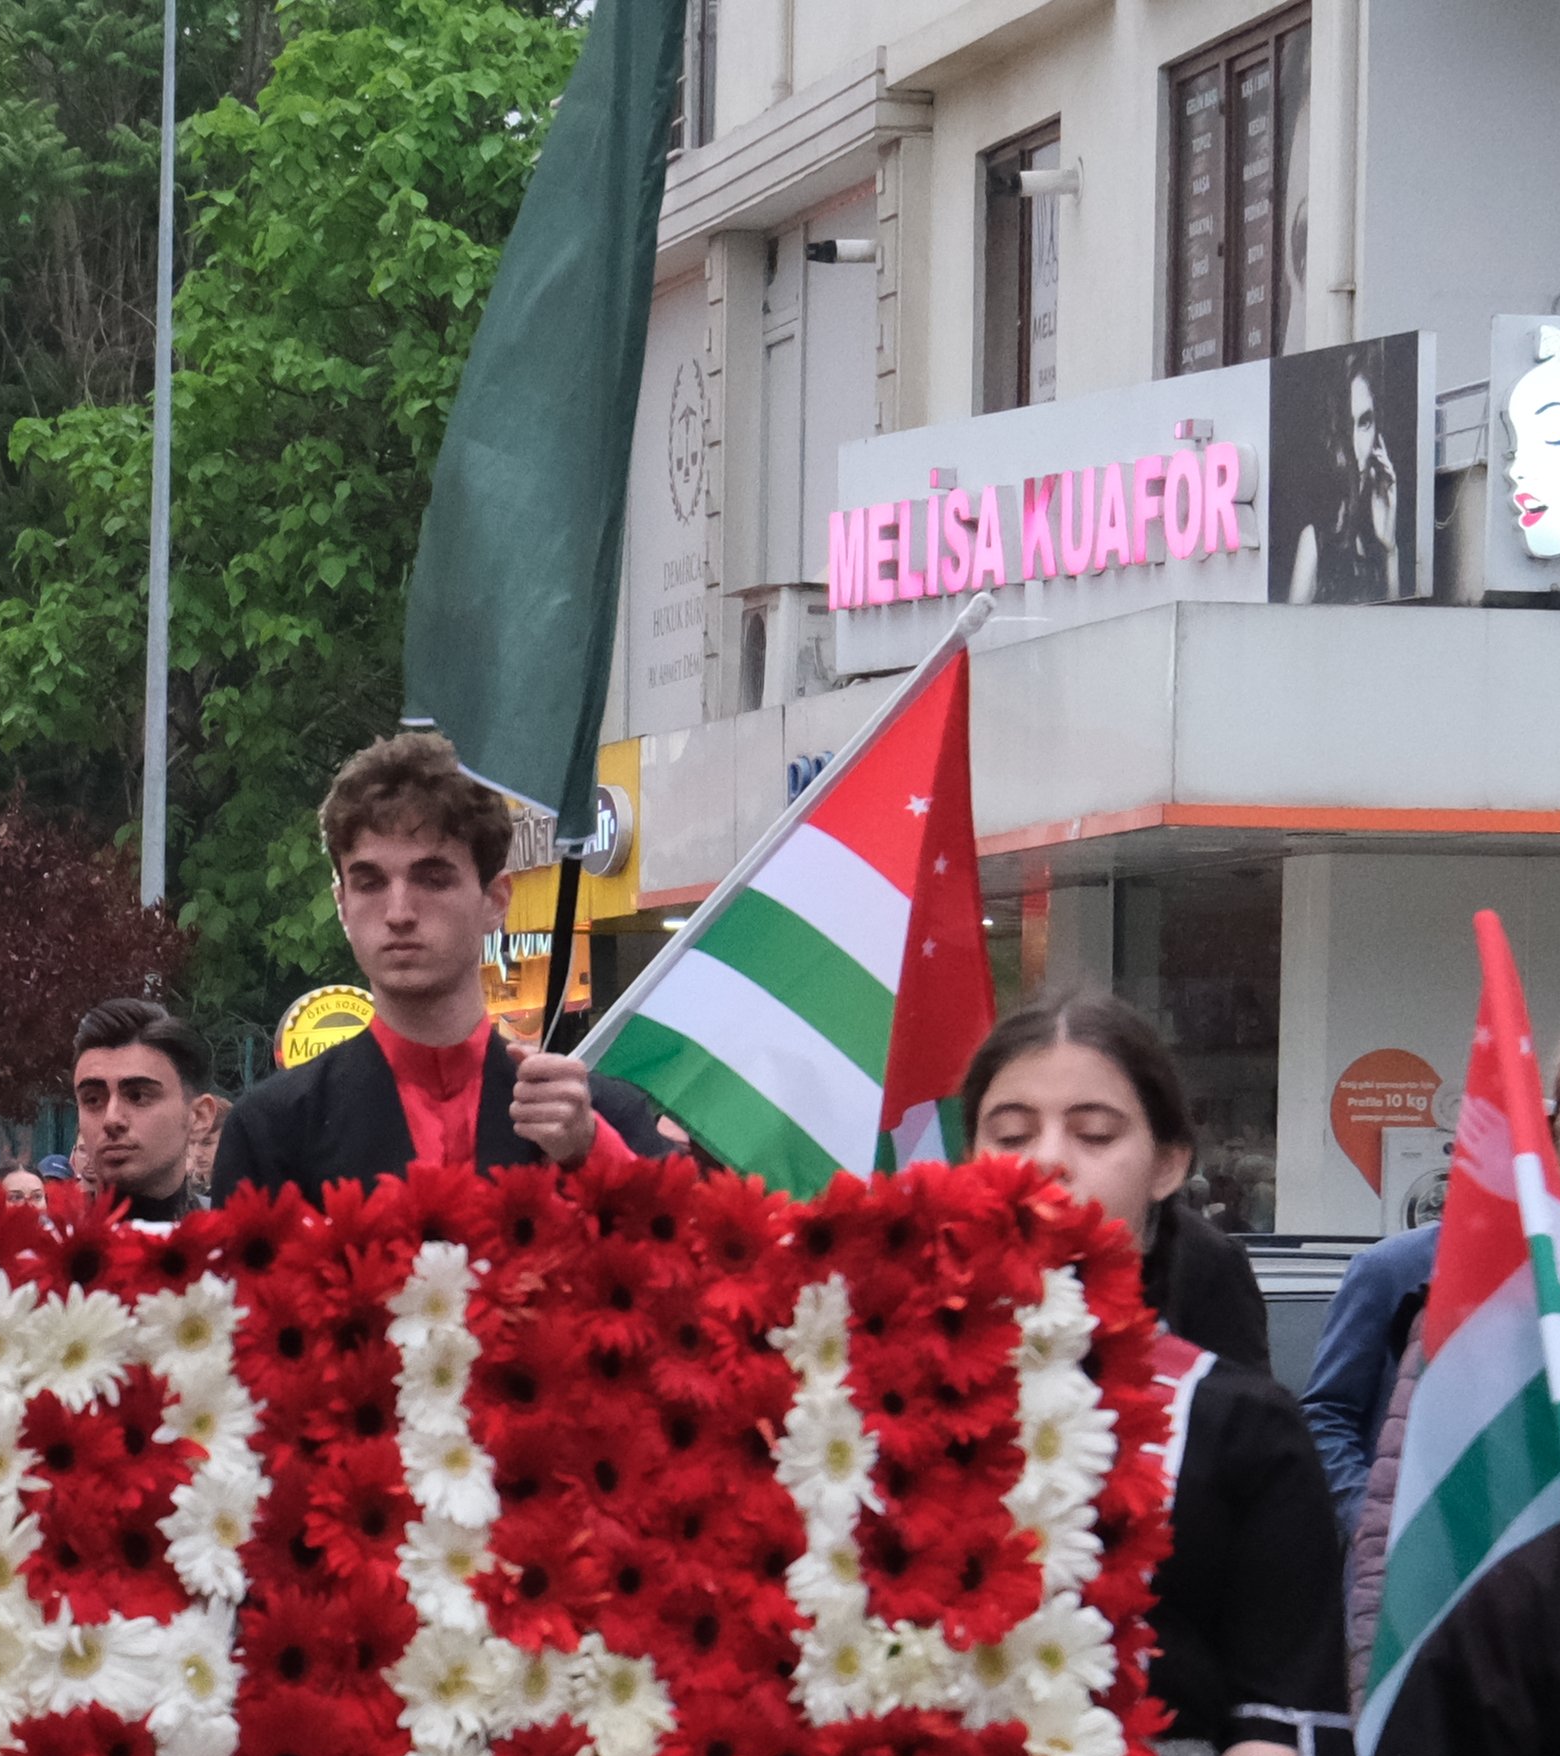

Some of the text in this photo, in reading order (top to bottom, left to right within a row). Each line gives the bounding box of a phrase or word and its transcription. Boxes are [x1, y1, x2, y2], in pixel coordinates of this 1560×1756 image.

[828, 418, 1241, 611] MELİSA KUAFÖR
[653, 601, 683, 638] HUKUK
[306, 1000, 369, 1020] ÖZEL SOSLU
[1347, 1092, 1428, 1112] Profilo 10 kg
